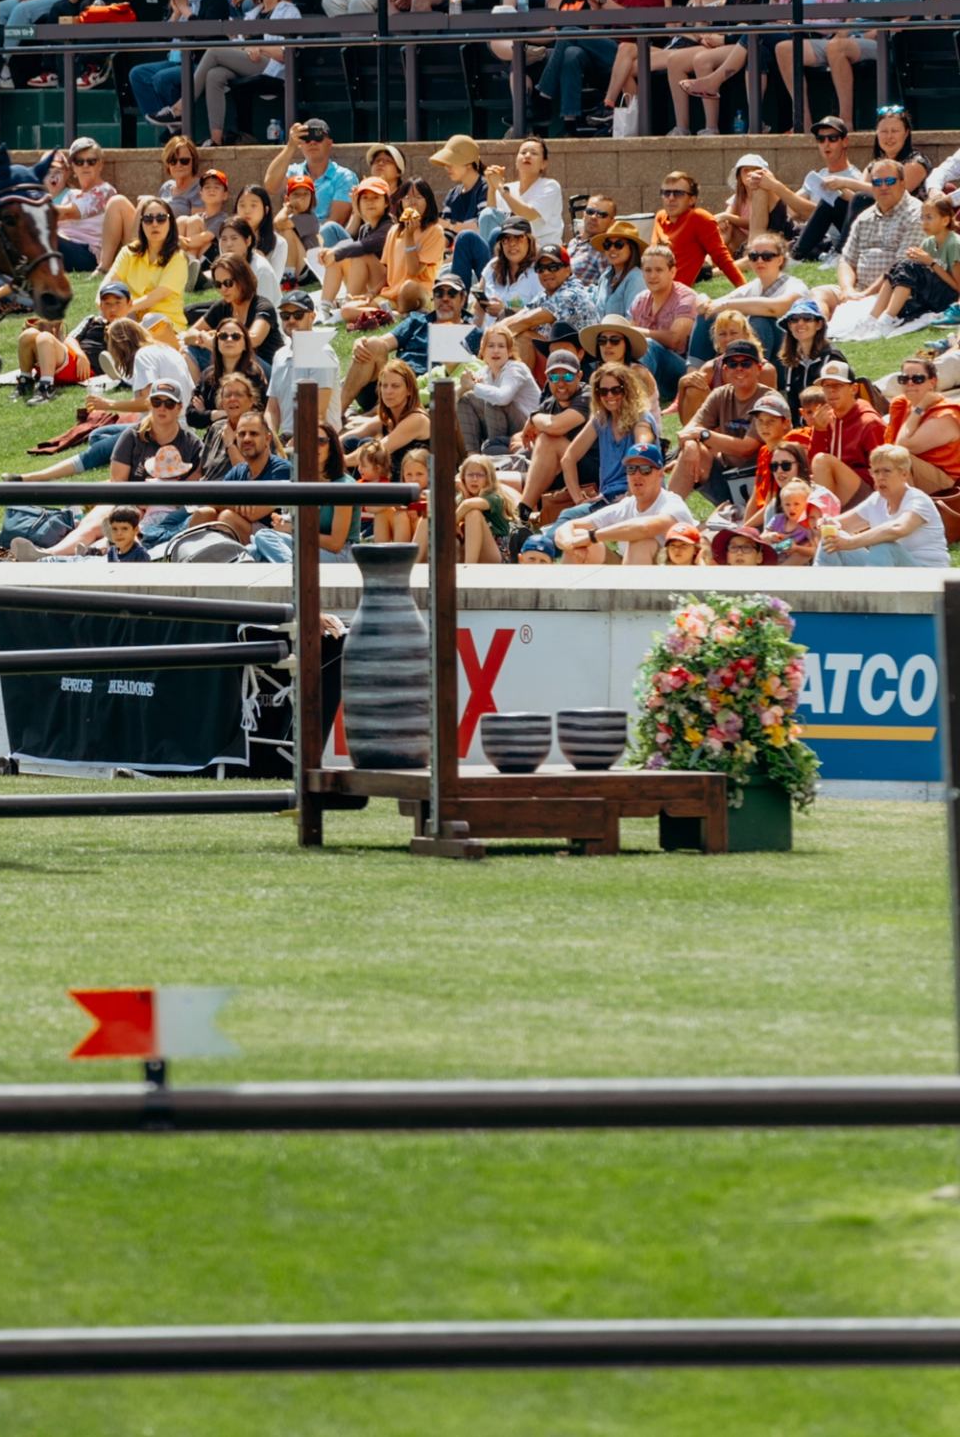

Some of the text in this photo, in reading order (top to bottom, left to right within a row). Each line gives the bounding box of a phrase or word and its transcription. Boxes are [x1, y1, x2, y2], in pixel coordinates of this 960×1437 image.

[61, 677, 155, 697] SPRUCE MEADOWS
[796, 652, 938, 717] ATCO
